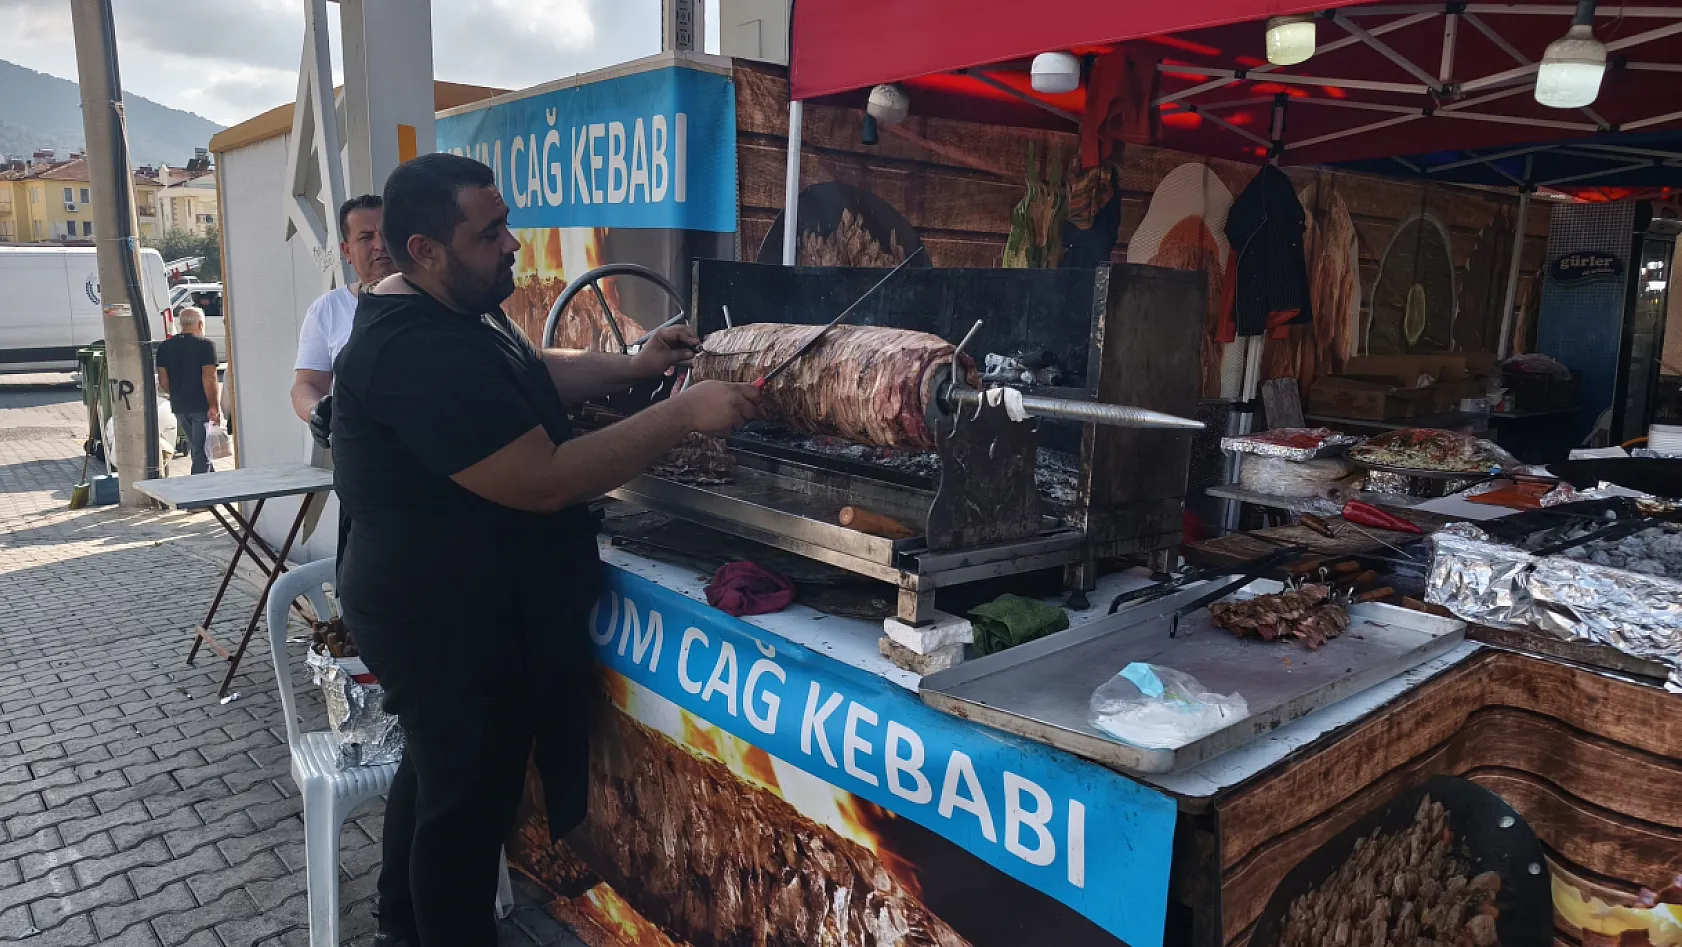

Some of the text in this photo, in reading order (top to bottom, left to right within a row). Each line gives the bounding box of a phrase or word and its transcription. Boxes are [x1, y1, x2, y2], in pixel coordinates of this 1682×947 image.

[510, 106, 564, 208] CAĞ
[571, 113, 687, 205] KEBABI
[1560, 255, 1614, 270] gürler
[677, 626, 787, 734] CAĞ
[800, 680, 1085, 889] KEBABI
